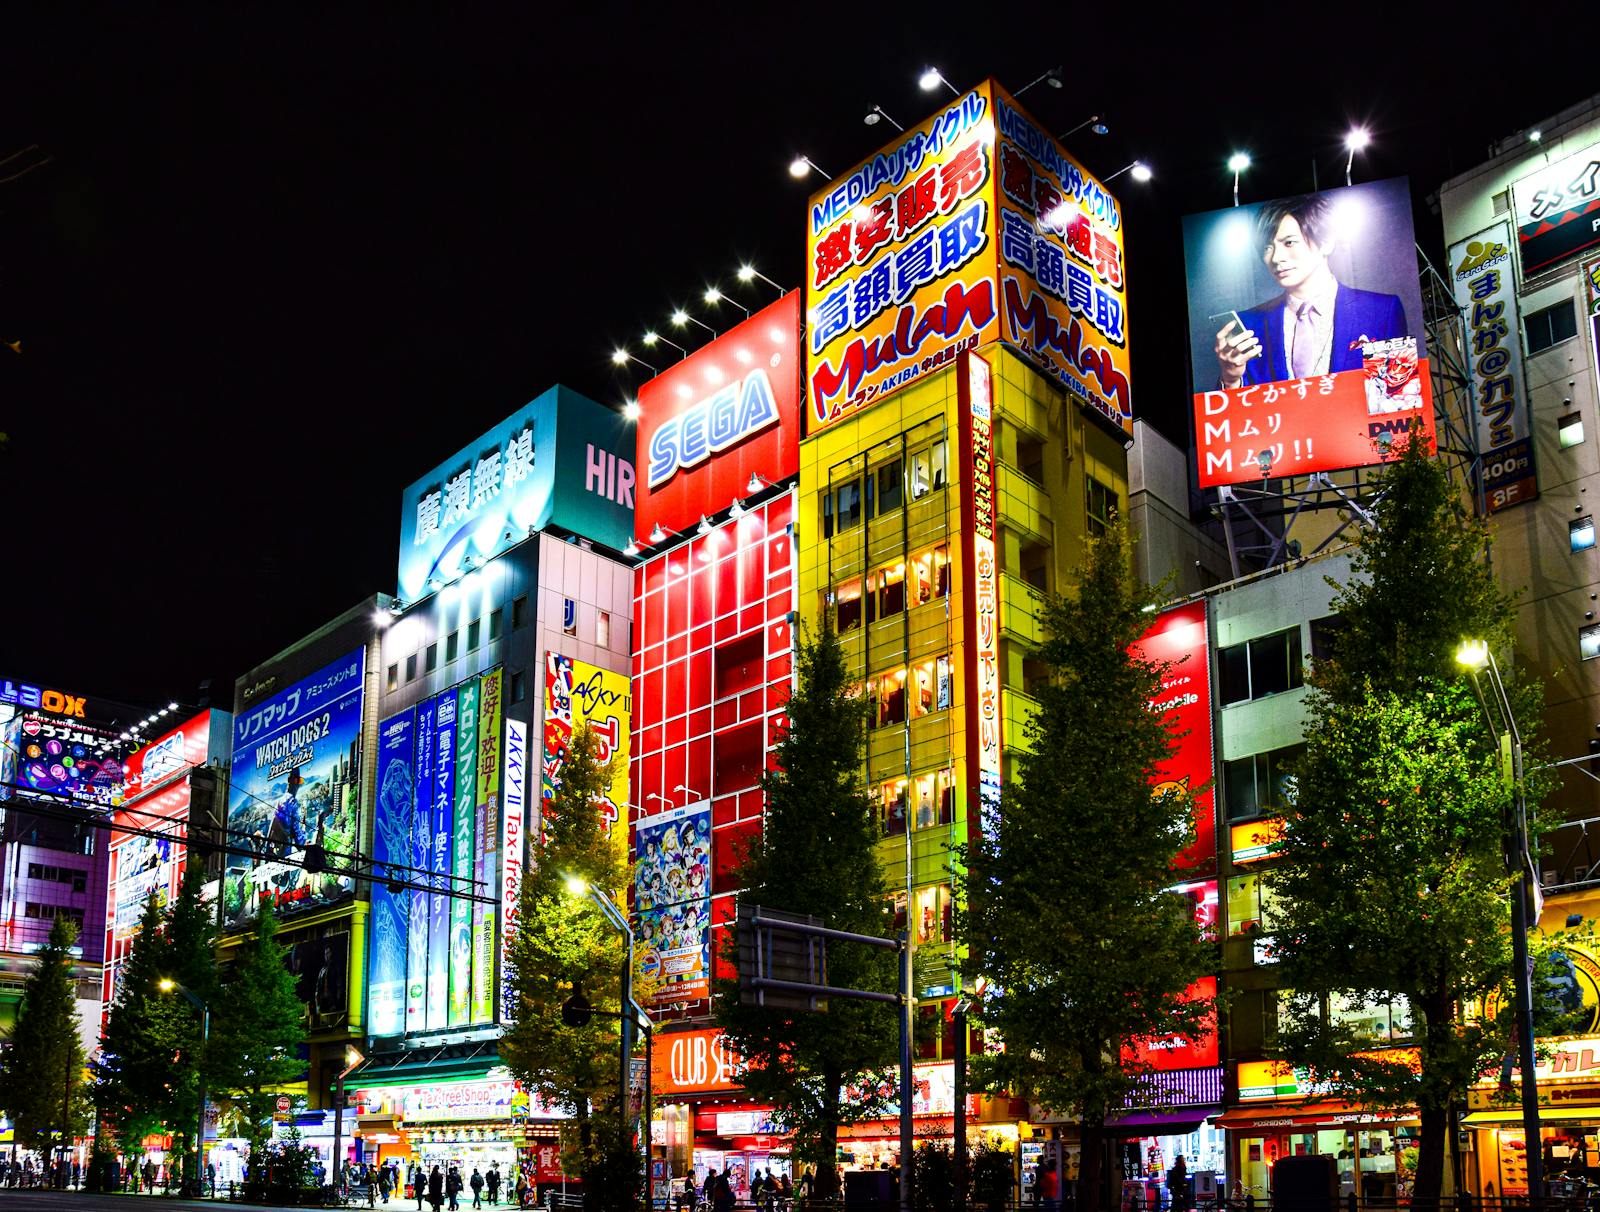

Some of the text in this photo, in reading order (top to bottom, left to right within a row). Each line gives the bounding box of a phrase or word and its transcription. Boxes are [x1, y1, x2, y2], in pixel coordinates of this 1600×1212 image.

[815, 142, 987, 289] 激安販売
[811, 200, 986, 353] 高額買取
[1002, 208, 1124, 342] 高額買取
[1456, 252, 1508, 282] GeraGera
[809, 277, 996, 421] Mulan
[1004, 278, 1132, 418] Mulan
[829, 385, 880, 420] ムーラン
[880, 365, 920, 393] AKIBA
[1060, 371, 1088, 400] AKIBA
[648, 368, 781, 490] SEGA
[973, 418, 990, 435] DVD
[975, 457, 989, 473] CD
[239, 688, 301, 740] ソフマップ
[572, 677, 621, 711] AKKY
[256, 712, 330, 768] WATCH DOGS 2
[508, 724, 524, 792] AKKY
[671, 1036, 708, 1087] CLUB
[464, 1087, 490, 1102] Shop
